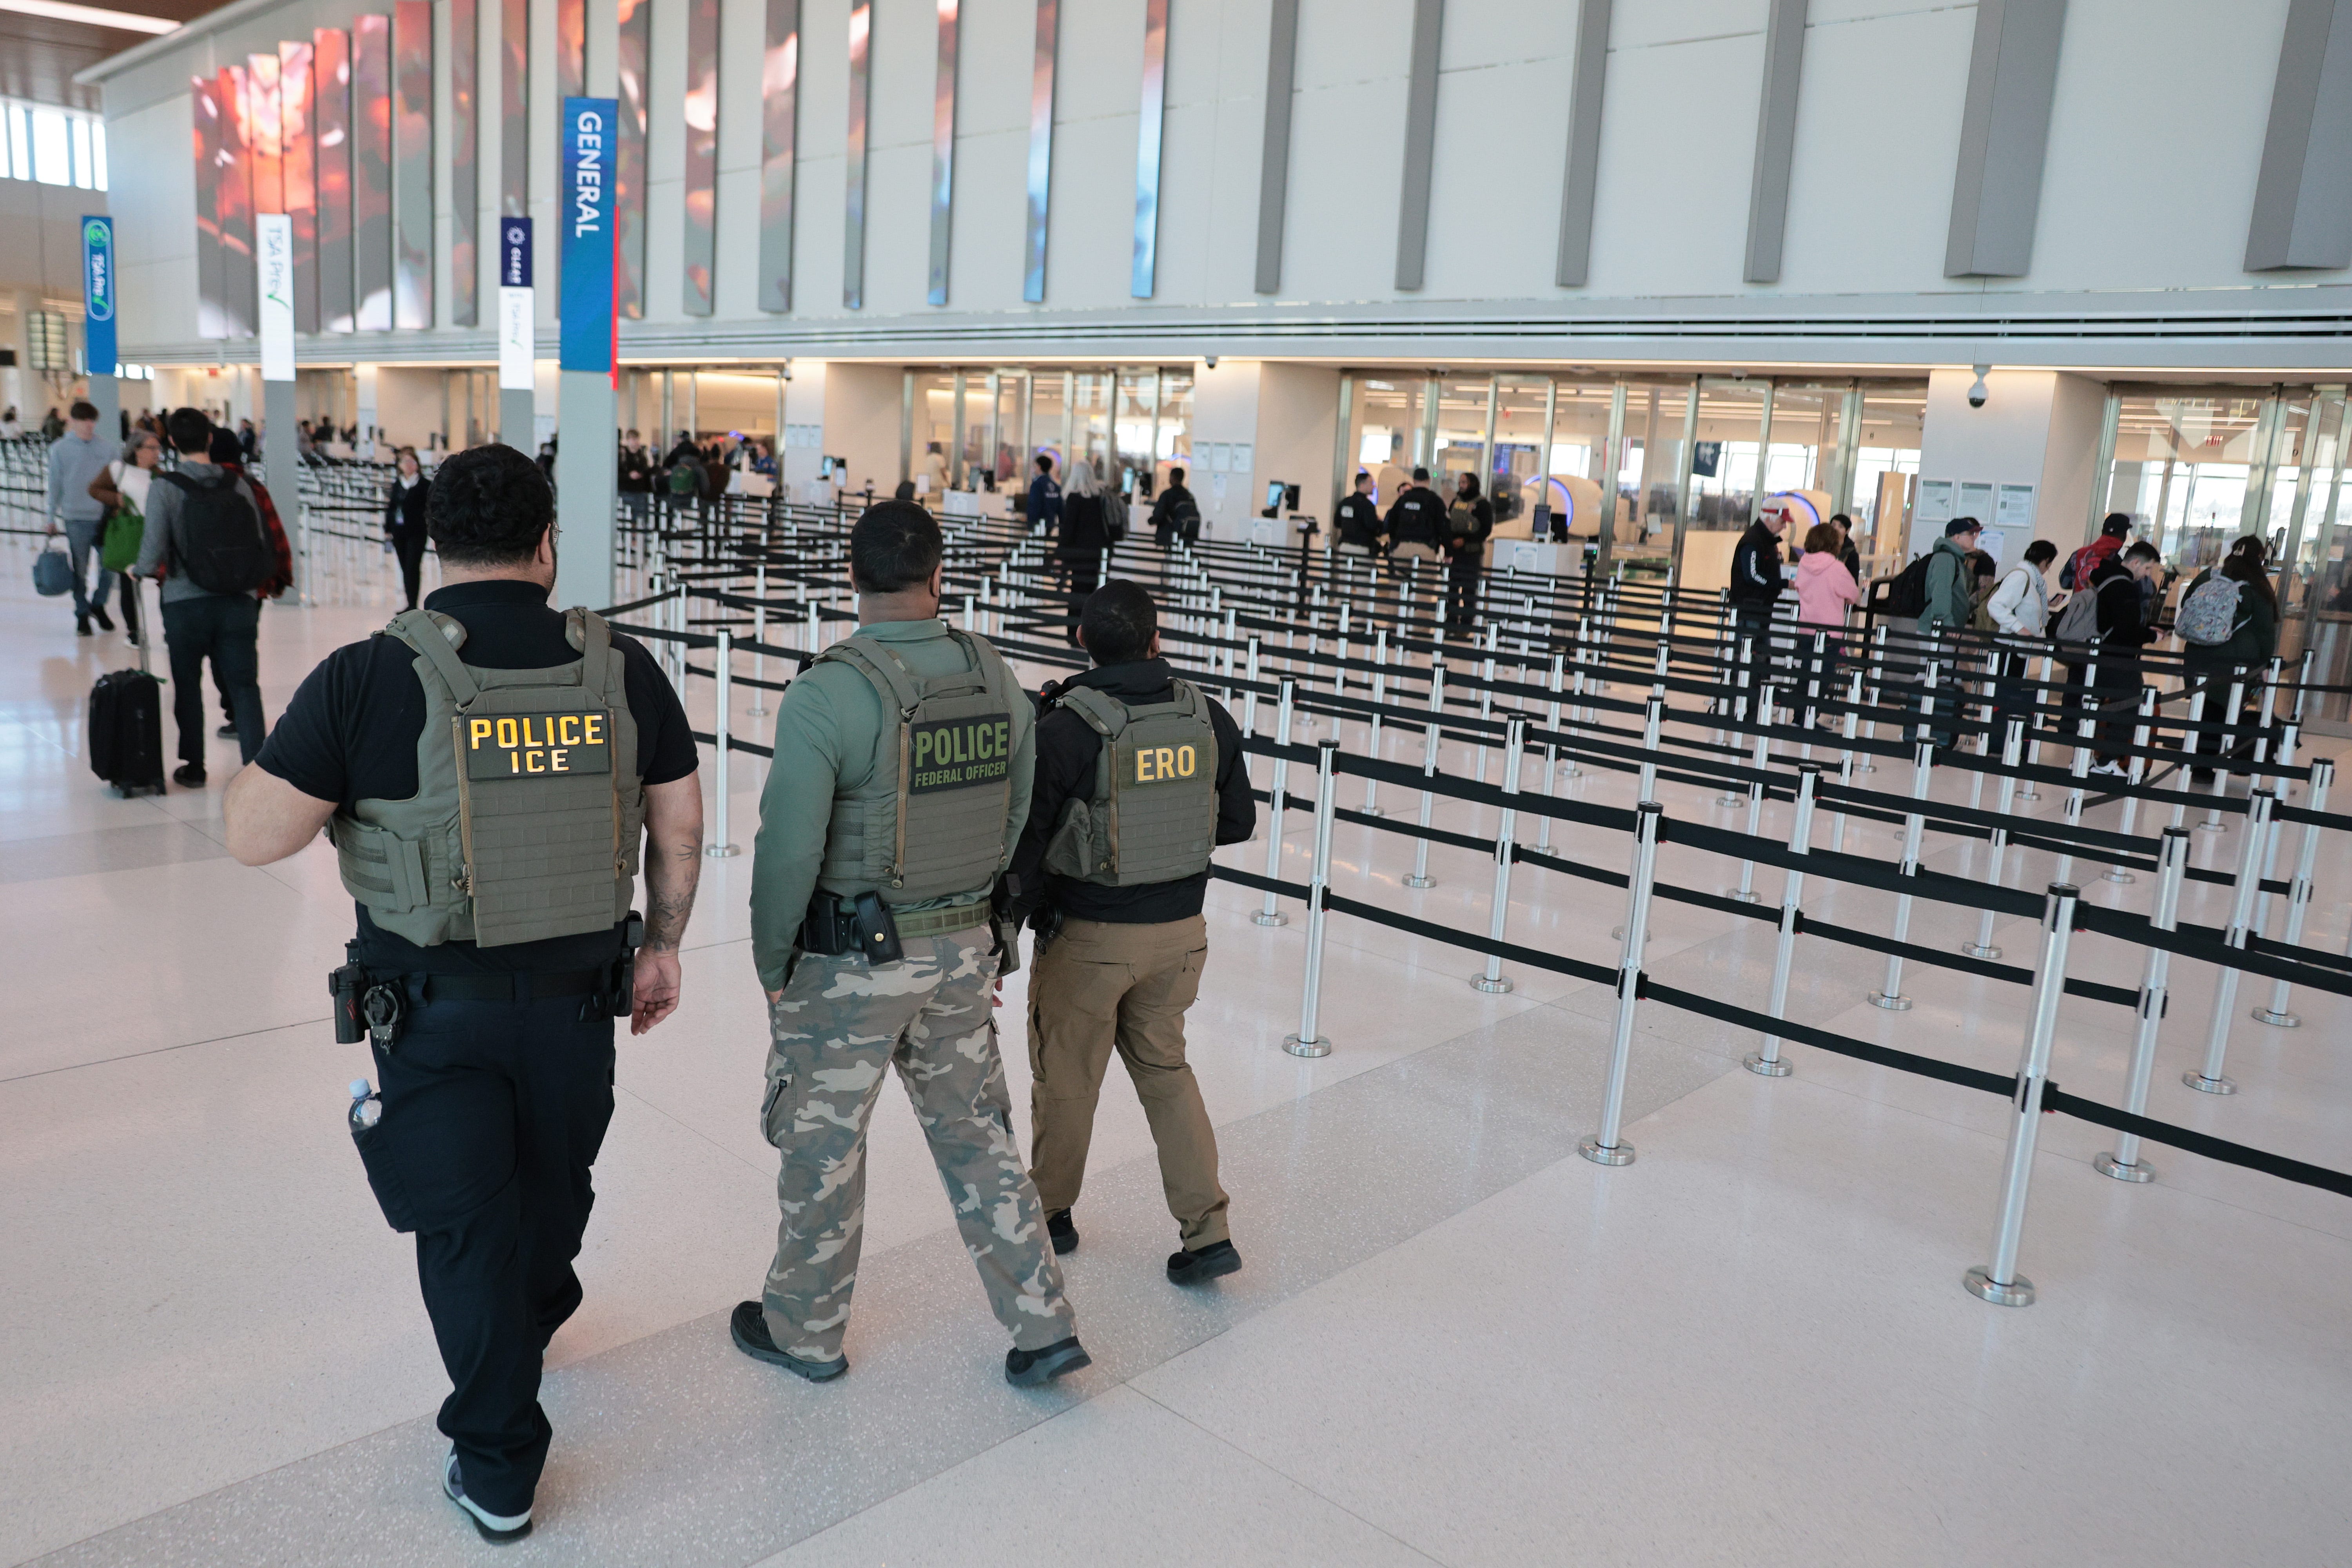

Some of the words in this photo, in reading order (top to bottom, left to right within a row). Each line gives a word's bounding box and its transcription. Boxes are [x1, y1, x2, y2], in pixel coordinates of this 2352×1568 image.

[575, 111, 602, 238] GENERAL
[268, 225, 283, 257] TSA
[510, 247, 521, 283] CLEAR
[470, 715, 604, 750] POLICE
[915, 721, 1008, 768] POLICE
[511, 749, 570, 773] ICE
[915, 768, 963, 788] FEDERAL
[966, 761, 1006, 780] OFFICER
[1137, 745, 1195, 781] ERO
